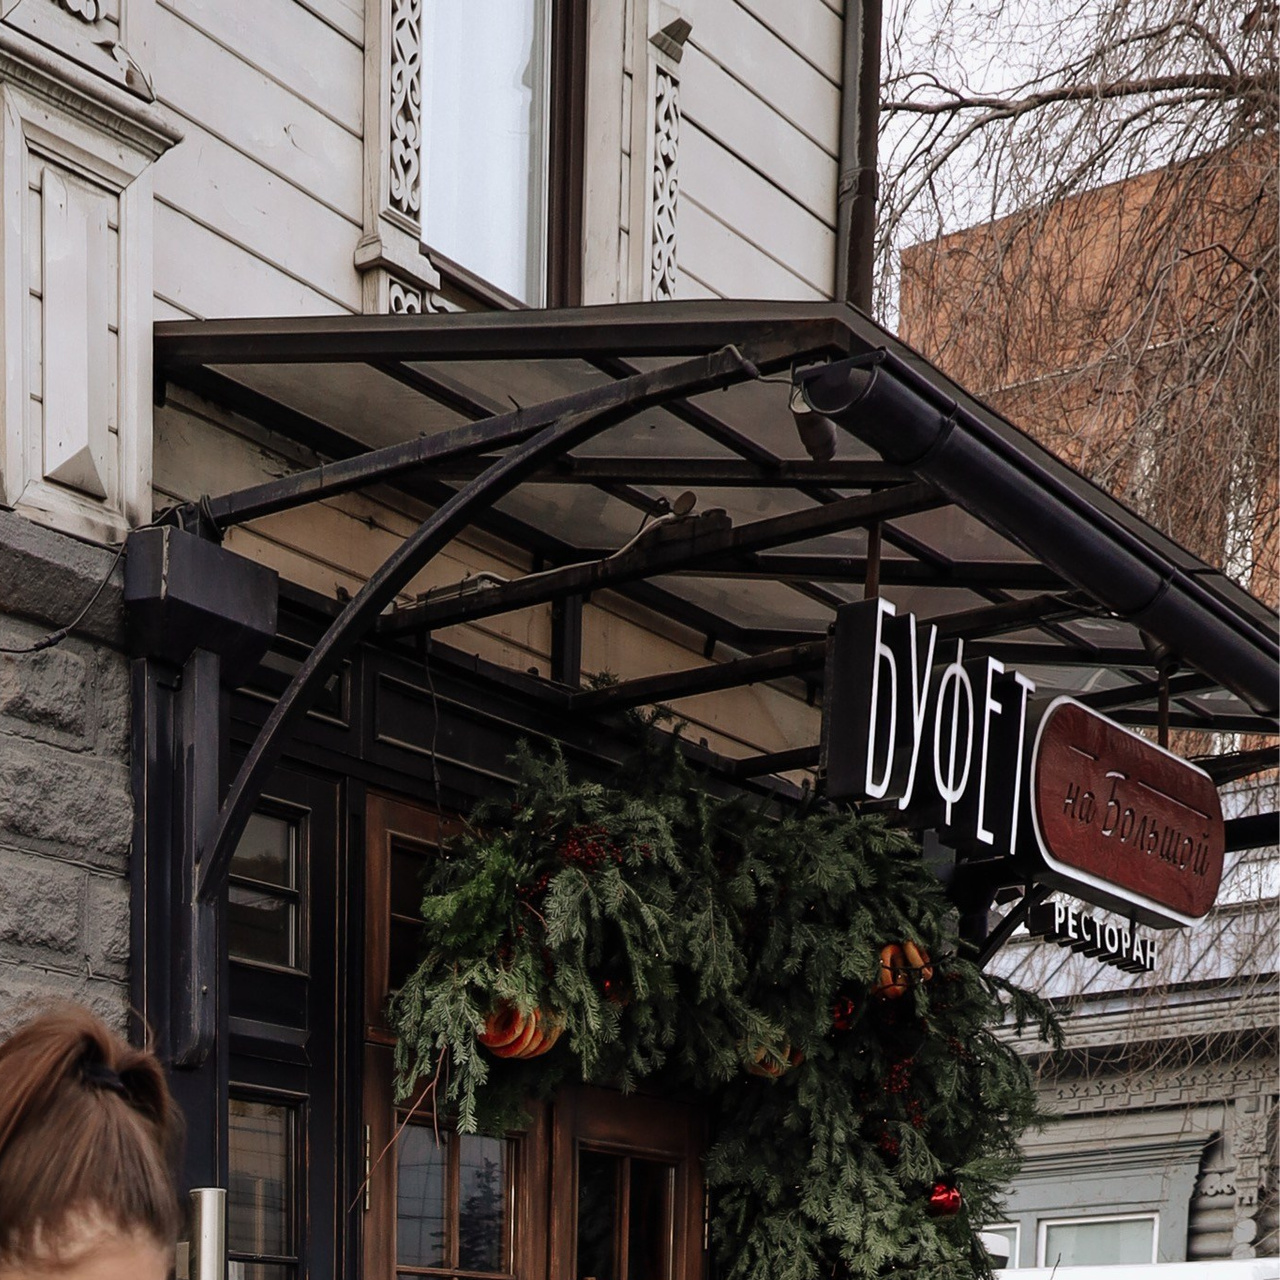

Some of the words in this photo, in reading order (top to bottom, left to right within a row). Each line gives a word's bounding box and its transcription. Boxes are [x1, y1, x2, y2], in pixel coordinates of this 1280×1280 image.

[865, 597, 1036, 855] БУФЕТ
[1063, 782, 1096, 824] на
[1102, 772, 1210, 877] Большой
[1055, 901, 1158, 970] РЕСТОРАН
